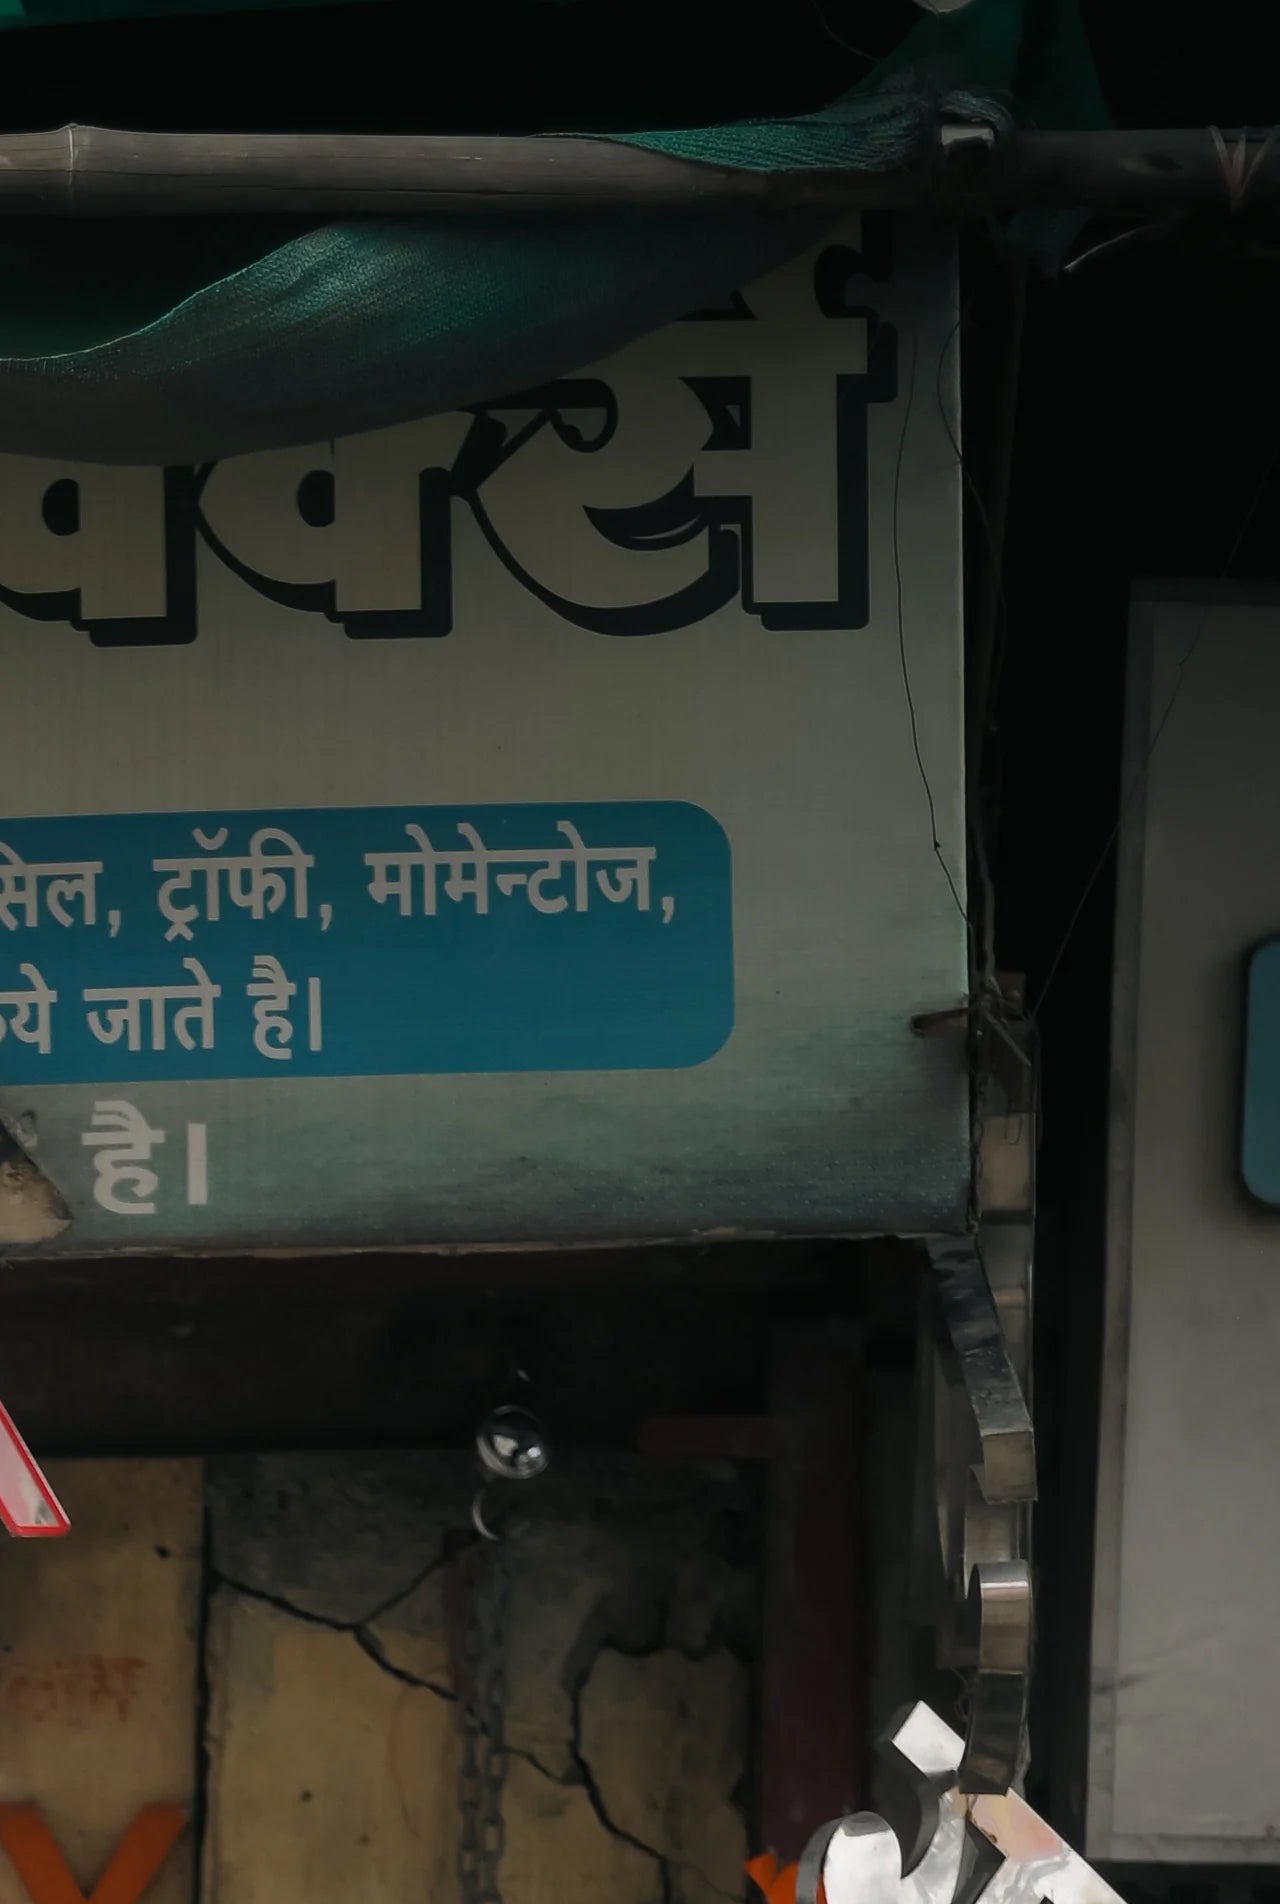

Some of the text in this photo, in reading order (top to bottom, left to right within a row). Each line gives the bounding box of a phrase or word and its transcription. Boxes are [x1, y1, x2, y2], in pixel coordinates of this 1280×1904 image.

[153, 828, 332, 941] ट्रॉफी,
[364, 821, 674, 923] मोमेन्टोज,
[83, 958, 221, 1051] जाते
